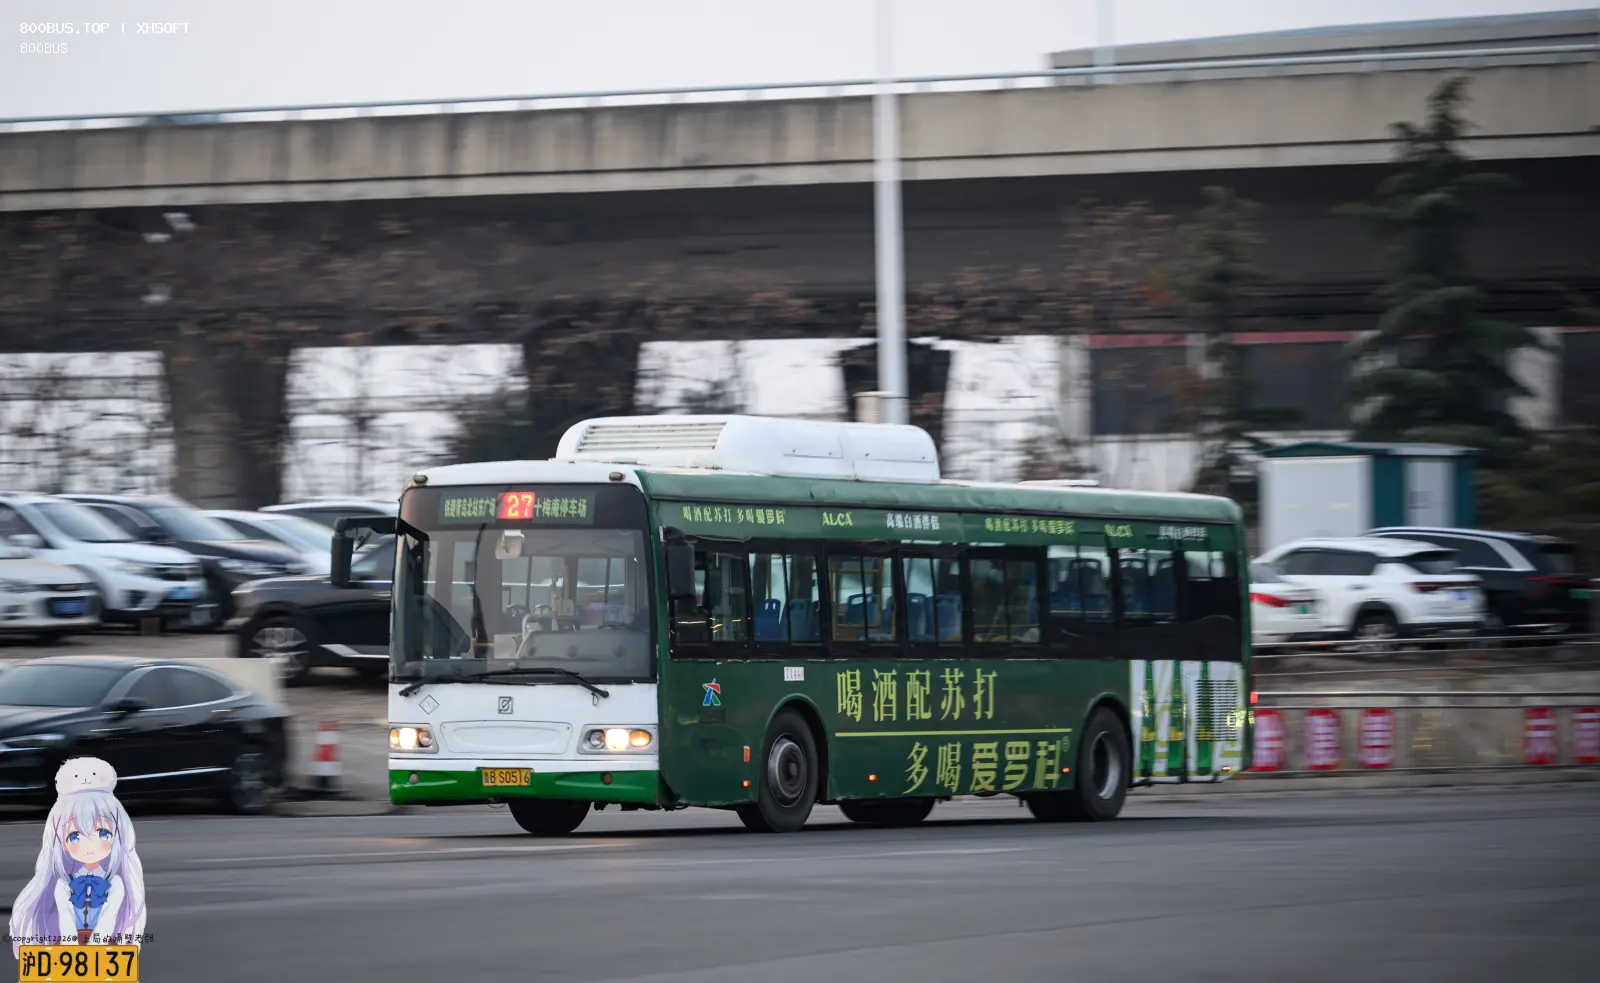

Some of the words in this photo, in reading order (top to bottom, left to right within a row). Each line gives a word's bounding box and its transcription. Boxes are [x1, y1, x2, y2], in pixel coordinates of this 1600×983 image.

[507, 494, 533, 517] 27
[822, 511, 853, 527] ALCA
[836, 667, 998, 723] 喝酒配苏打
[902, 740, 1062, 795] 多喝爱罗科
